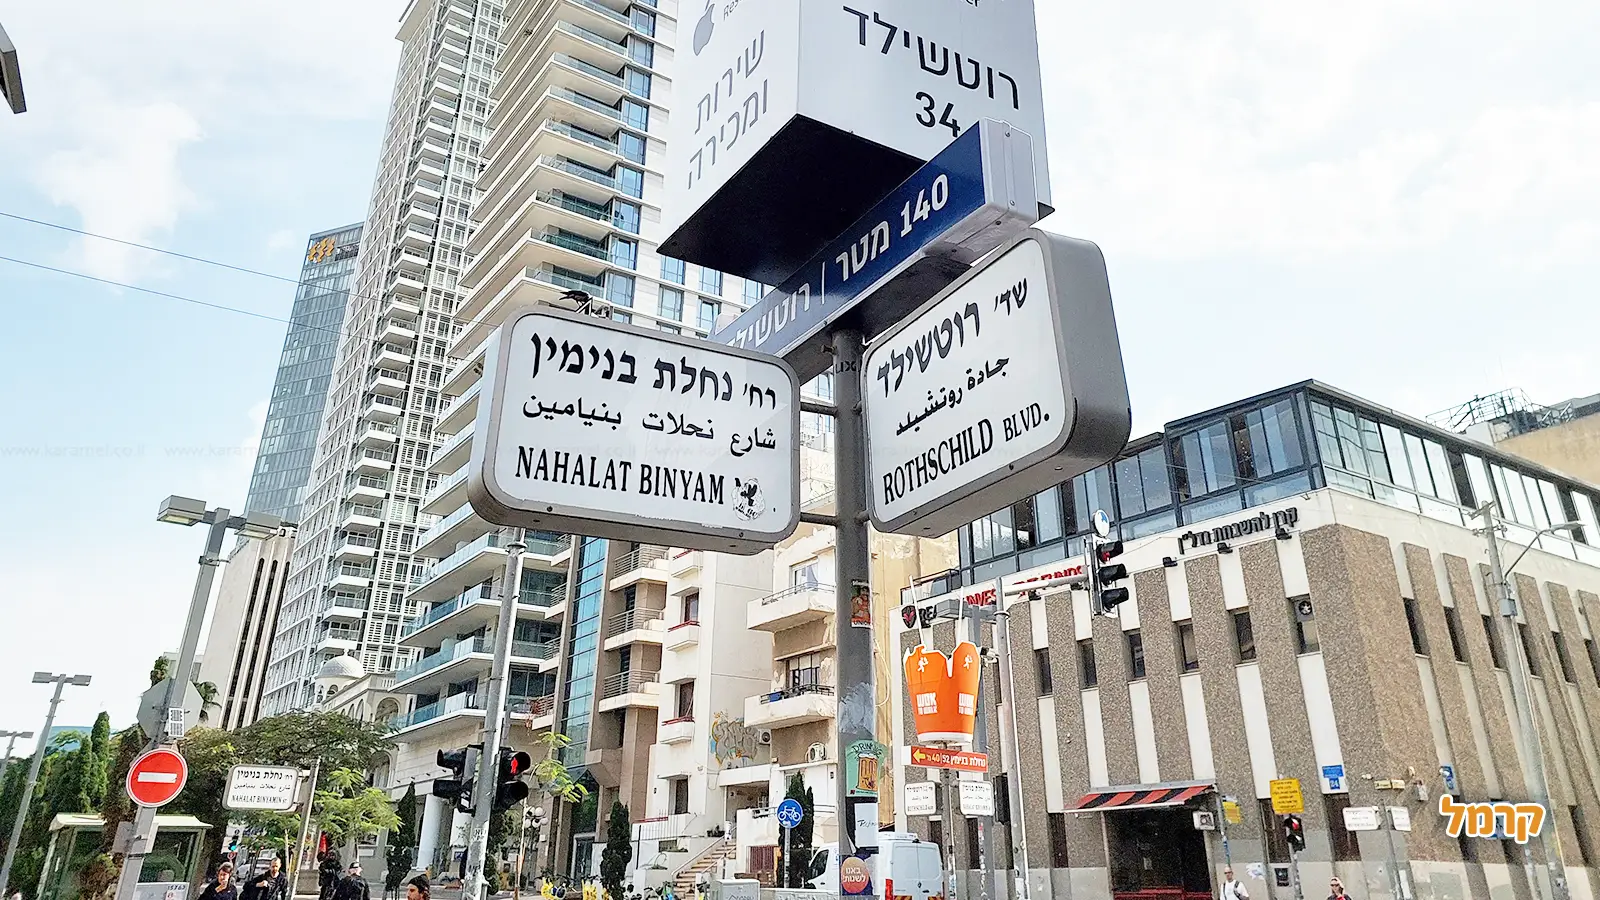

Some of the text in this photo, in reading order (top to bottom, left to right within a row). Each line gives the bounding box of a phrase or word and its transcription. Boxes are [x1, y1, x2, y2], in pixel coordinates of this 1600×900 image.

[842, 5, 1019, 110] רוטשילד
[695, 30, 765, 135] שירות
[688, 79, 768, 190] ומכירה
[915, 91, 961, 138] 34
[836, 173, 949, 282] 140 מטר
[530, 332, 638, 385] בנימין
[877, 302, 980, 398] רוטשילד
[653, 356, 733, 402] נחלת
[896, 356, 1010, 436] جادة روتشيلد
[523, 395, 622, 430] بنيامين
[642, 411, 714, 440] نحلات
[730, 428, 776, 457] شارع
[882, 402, 1050, 505] ROTHSCHILD BLVD.
[514, 446, 724, 506] NAHALAT BINYAM
[1272, 507, 1298, 529] קרן
[237, 770, 261, 780] בנימין
[263, 770, 283, 780] נחלת
[932, 753, 940, 762] 40
[942, 754, 950, 764] 52
[232, 795, 256, 803] NAHALAT
[257, 796, 282, 804] BINYAMIN
